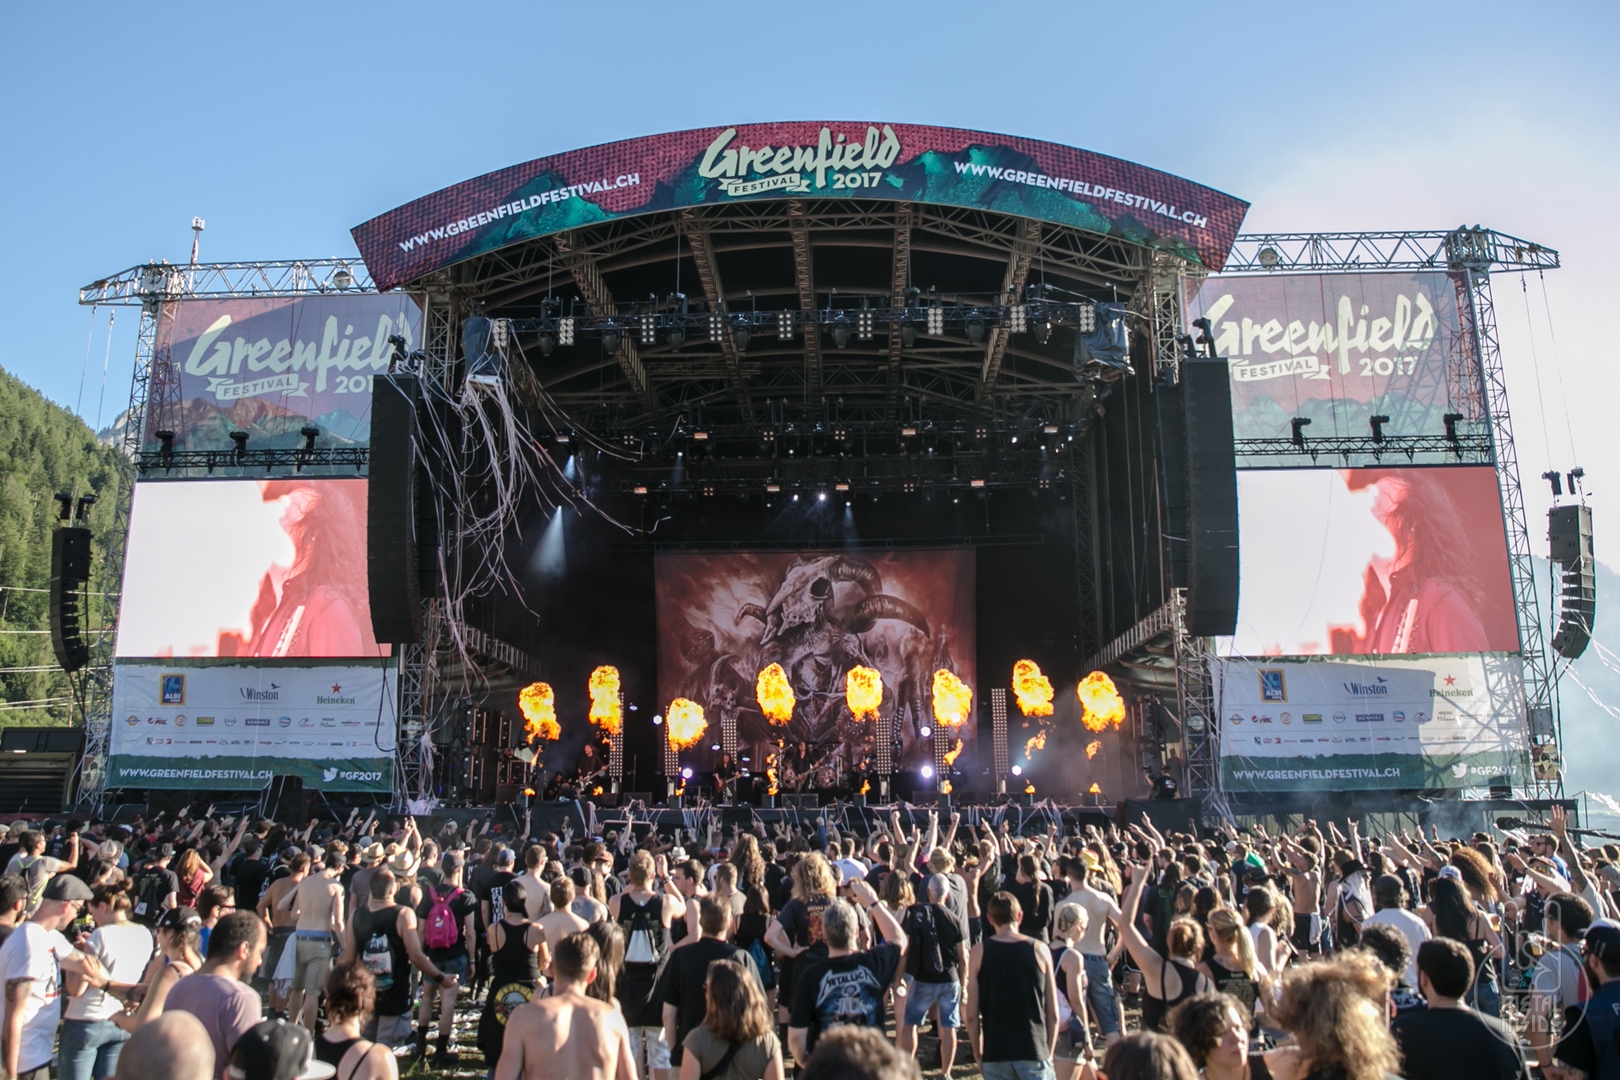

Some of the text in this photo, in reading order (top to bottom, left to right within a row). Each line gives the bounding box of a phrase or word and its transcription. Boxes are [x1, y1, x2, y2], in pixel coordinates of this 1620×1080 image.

[699, 124, 901, 188] Greenfield
[733, 172, 882, 194] FESTIVAL 2017
[954, 161, 1208, 229] WWW.GREENFIELDFESTIVAL.CH
[399, 172, 641, 253] WWW.GREENFIELDFESTIVAL.CH
[1239, 356, 1419, 379] FESTIVAL 2017
[223, 375, 373, 397] FESTIVAL 201
[246, 688, 279, 700] Winston
[1351, 682, 1388, 695] Winston
[1429, 689, 1474, 698] Heineken
[316, 696, 356, 705] Heineken
[119, 768, 274, 780] WWW.GREENFIELDFESTIVAL.CH
[339, 770, 383, 782] #GF2017
[1232, 767, 1401, 780] WWW.GREENFIELDFESTIVAL.CH
[1470, 764, 1518, 776] #GF2017
[816, 964, 881, 1008] METALLICA
